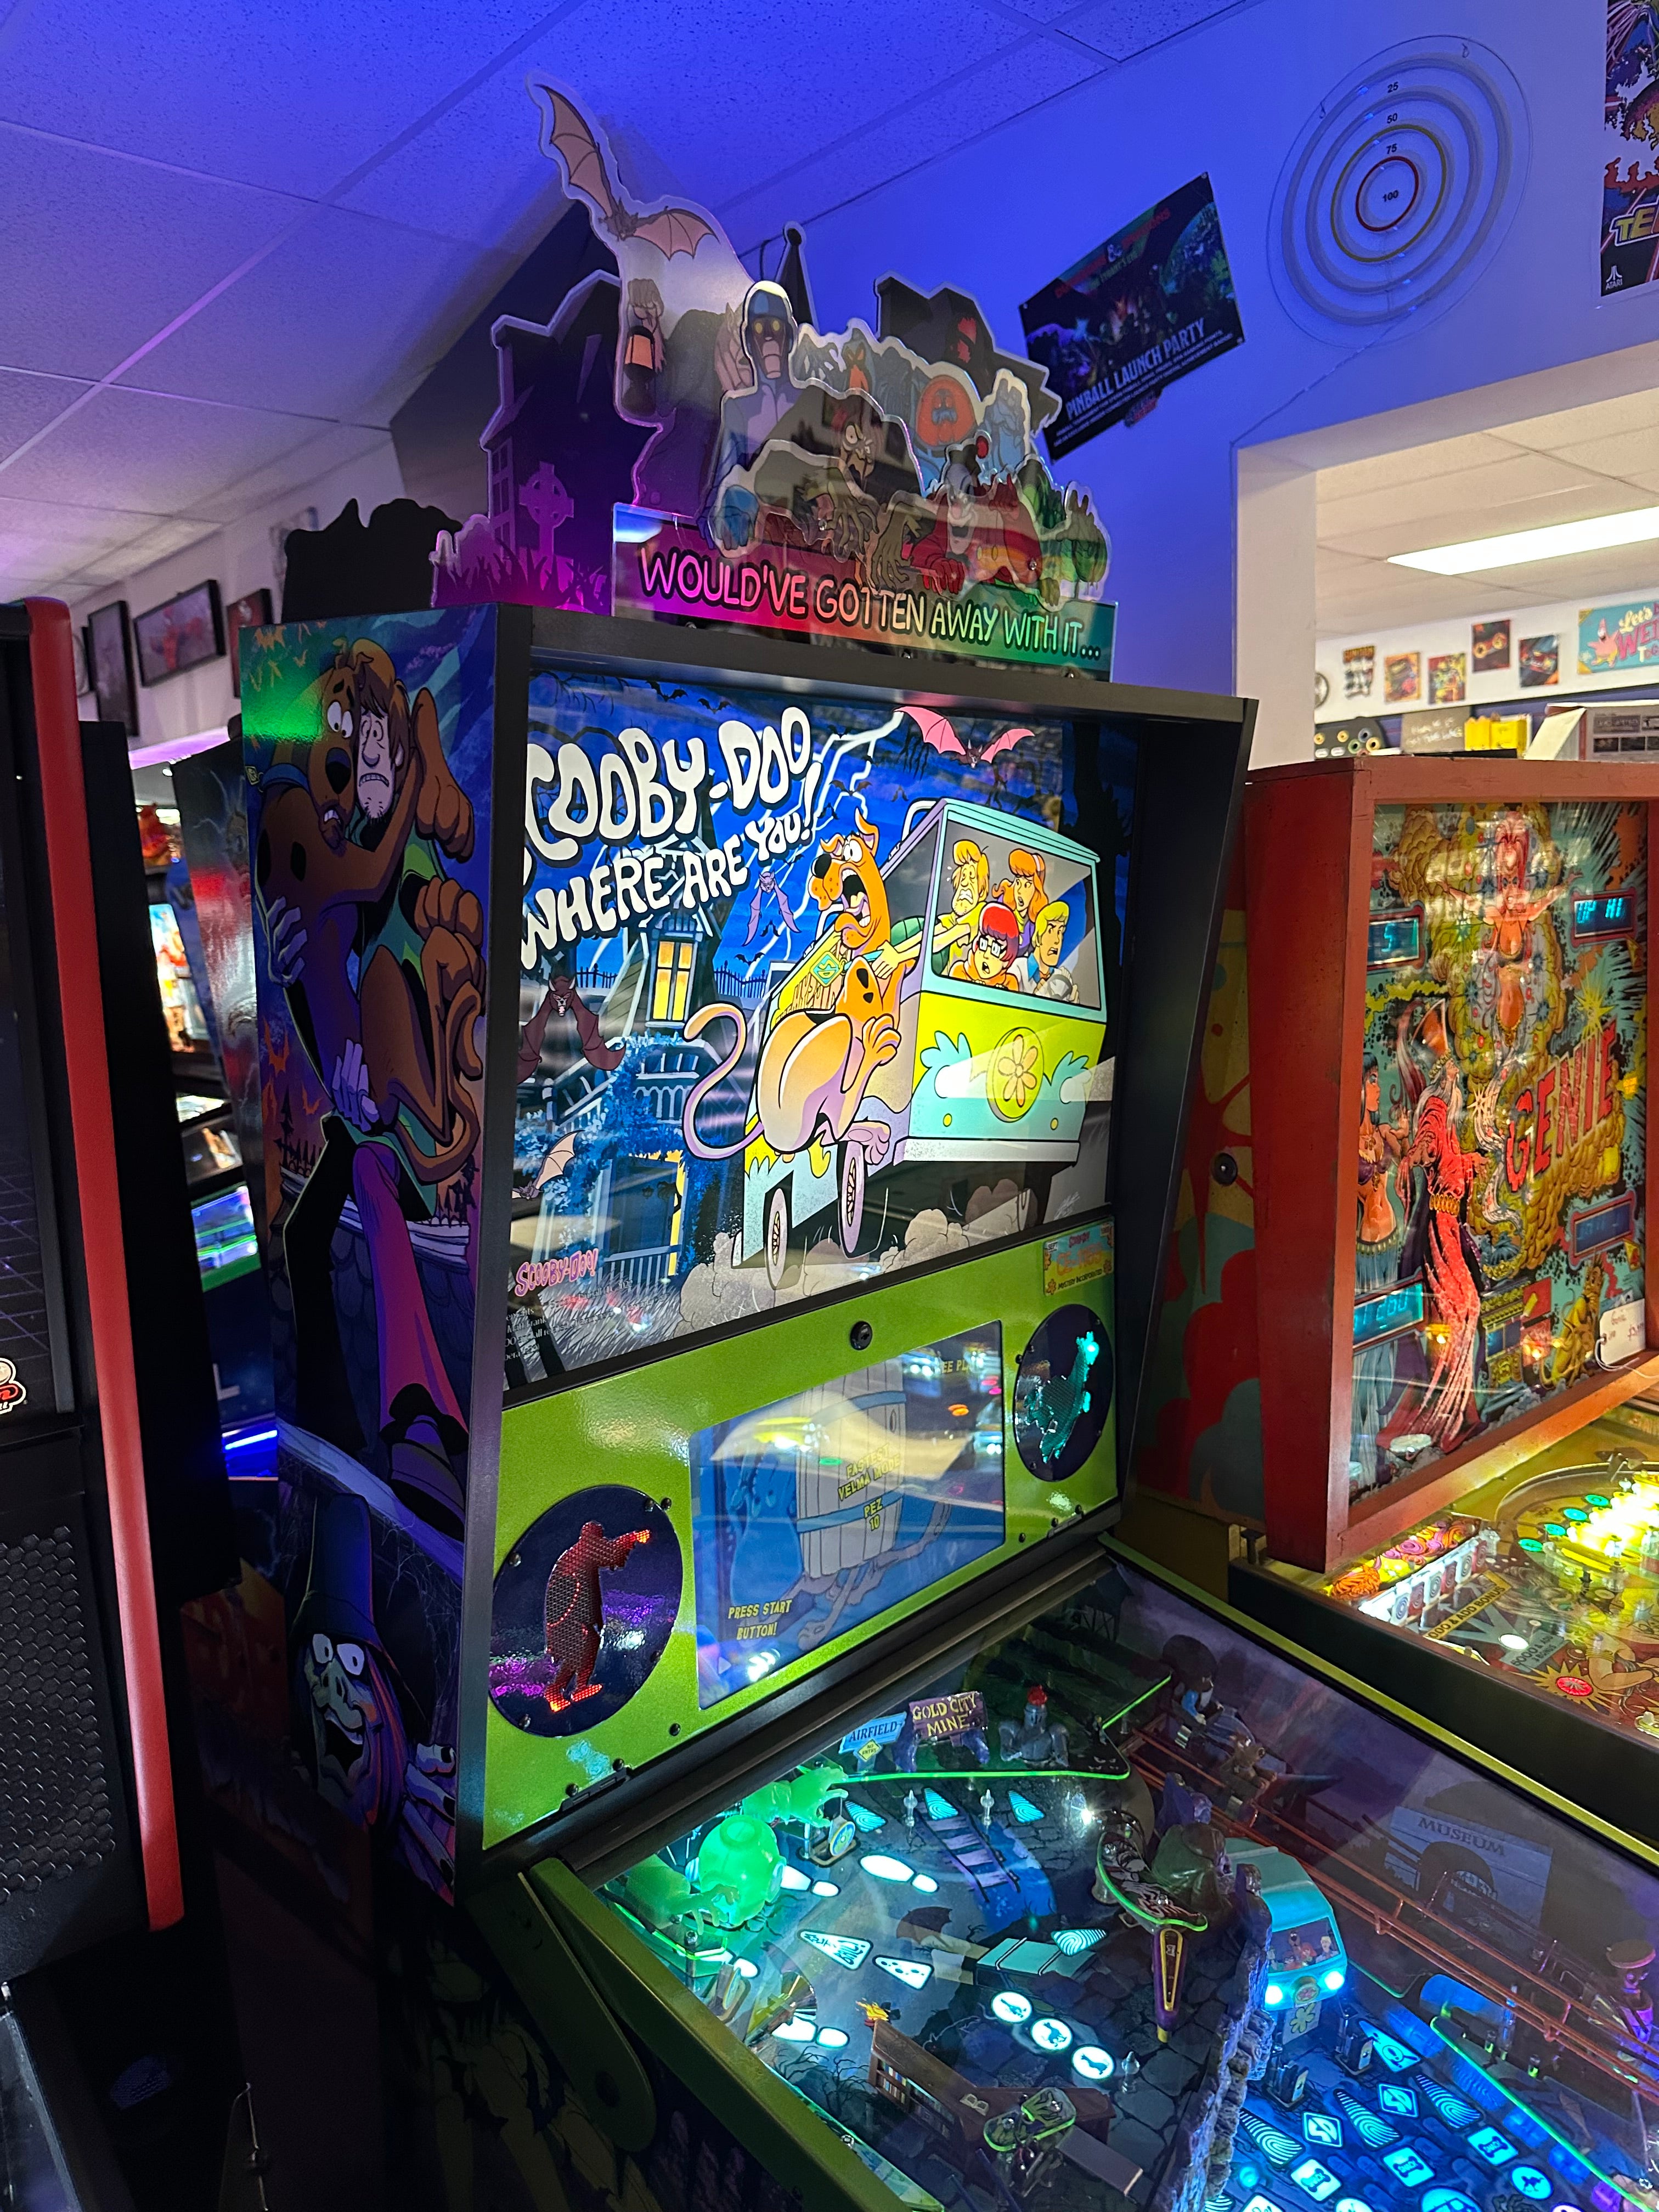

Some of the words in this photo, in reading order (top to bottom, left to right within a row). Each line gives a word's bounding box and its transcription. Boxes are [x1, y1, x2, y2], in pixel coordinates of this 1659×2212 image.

[1387, 82, 1398, 93] 25
[1387, 113, 1398, 123] 50
[1386, 144, 1397, 154] 75
[1383, 190, 1399, 202] 100
[1615, 206, 1659, 241] TE
[1605, 278, 1623, 290] ATARI
[1065, 377, 1115, 420] PINBALL
[1114, 345, 1163, 389] LAUNCH
[1163, 317, 1205, 357] PARTY
[640, 549, 807, 617] WOULD'VE
[816, 579, 924, 631] GOTTEN
[931, 600, 999, 642] AWAY
[1002, 612, 1058, 652] WITH
[1062, 621, 1101, 658] IT...
[521, 856, 674, 970] WHERE
[683, 834, 750, 909] ARE
[745, 761, 822, 862] YOU!
[1506, 1018, 1617, 1192] GENIE
[514, 1248, 599, 1297] SCOOBY-DOO!
[847, 1443, 890, 1479] FASTEST
[838, 1472, 871, 1502] VELMA
[874, 1453, 901, 1484] MODE
[864, 1496, 883, 1519] PEZ
[869, 1514, 881, 1531] 10
[728, 1603, 759, 1619] PRESS
[763, 1599, 792, 1615] START
[1427, 1622, 1452, 1640] 000
[1458, 1605, 1478, 1620] ADD
[1475, 1585, 1506, 1607] BONUS
[736, 1623, 776, 1640] BUTTON!
[912, 1701, 947, 1721] GOLD
[950, 1692, 977, 1714] CITY
[850, 1720, 898, 1742] AIRFIELD
[927, 1713, 970, 1737] MINE
[862, 1747, 877, 1757] ENTRY
[1418, 1817, 1505, 1857] MUSEUM
